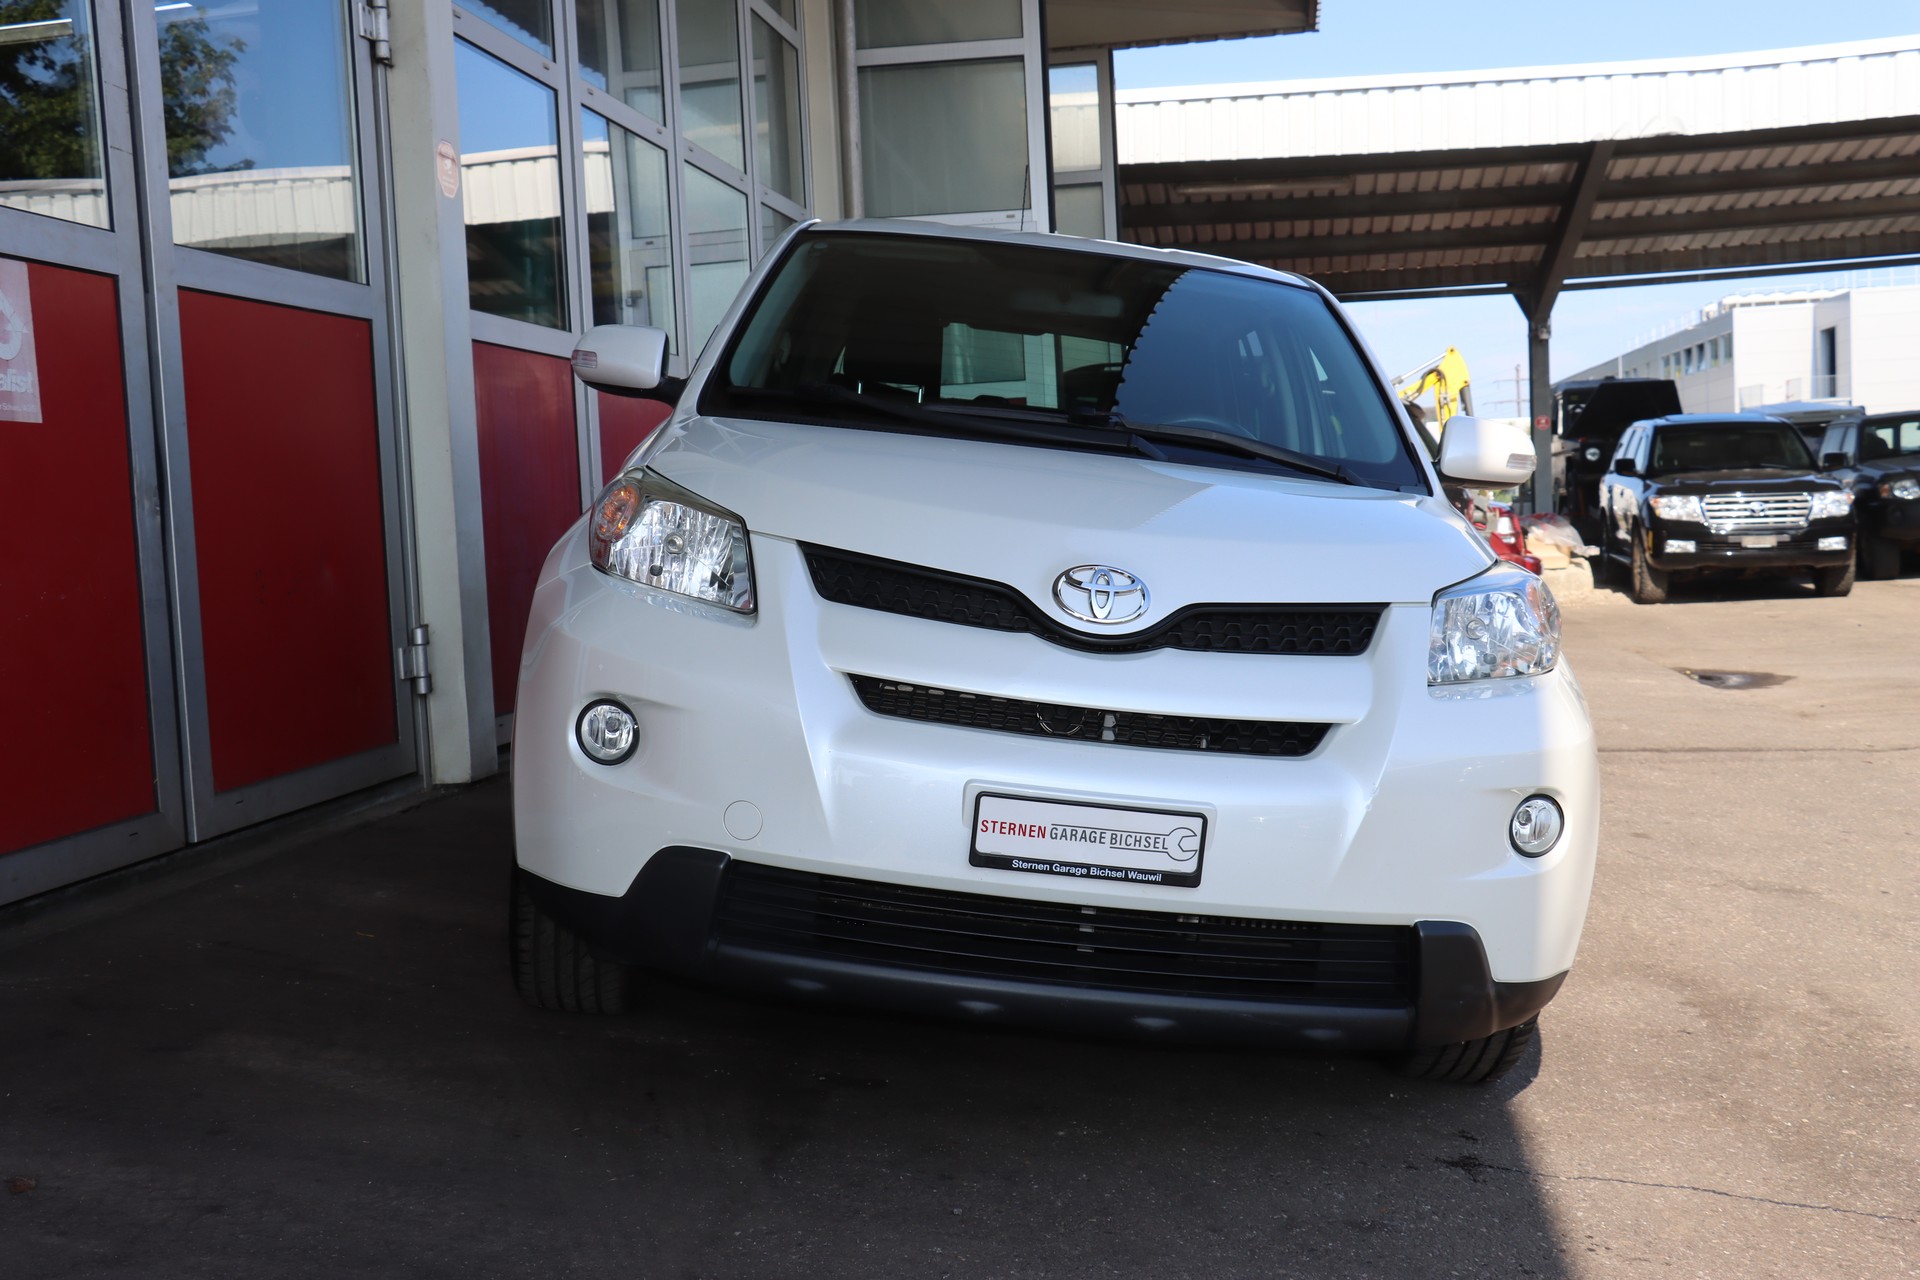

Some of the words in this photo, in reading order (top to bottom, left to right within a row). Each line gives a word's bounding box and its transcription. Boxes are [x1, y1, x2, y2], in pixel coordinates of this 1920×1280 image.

[980, 819, 1047, 839] STERNEN
[1049, 826, 1107, 845] GARAGE
[1109, 832, 1169, 850] BICHSEL
[1011, 859, 1050, 871] Sternen
[1052, 863, 1088, 876] Garage
[1089, 866, 1126, 879] Bichsel
[1127, 870, 1163, 882] Wauwil
